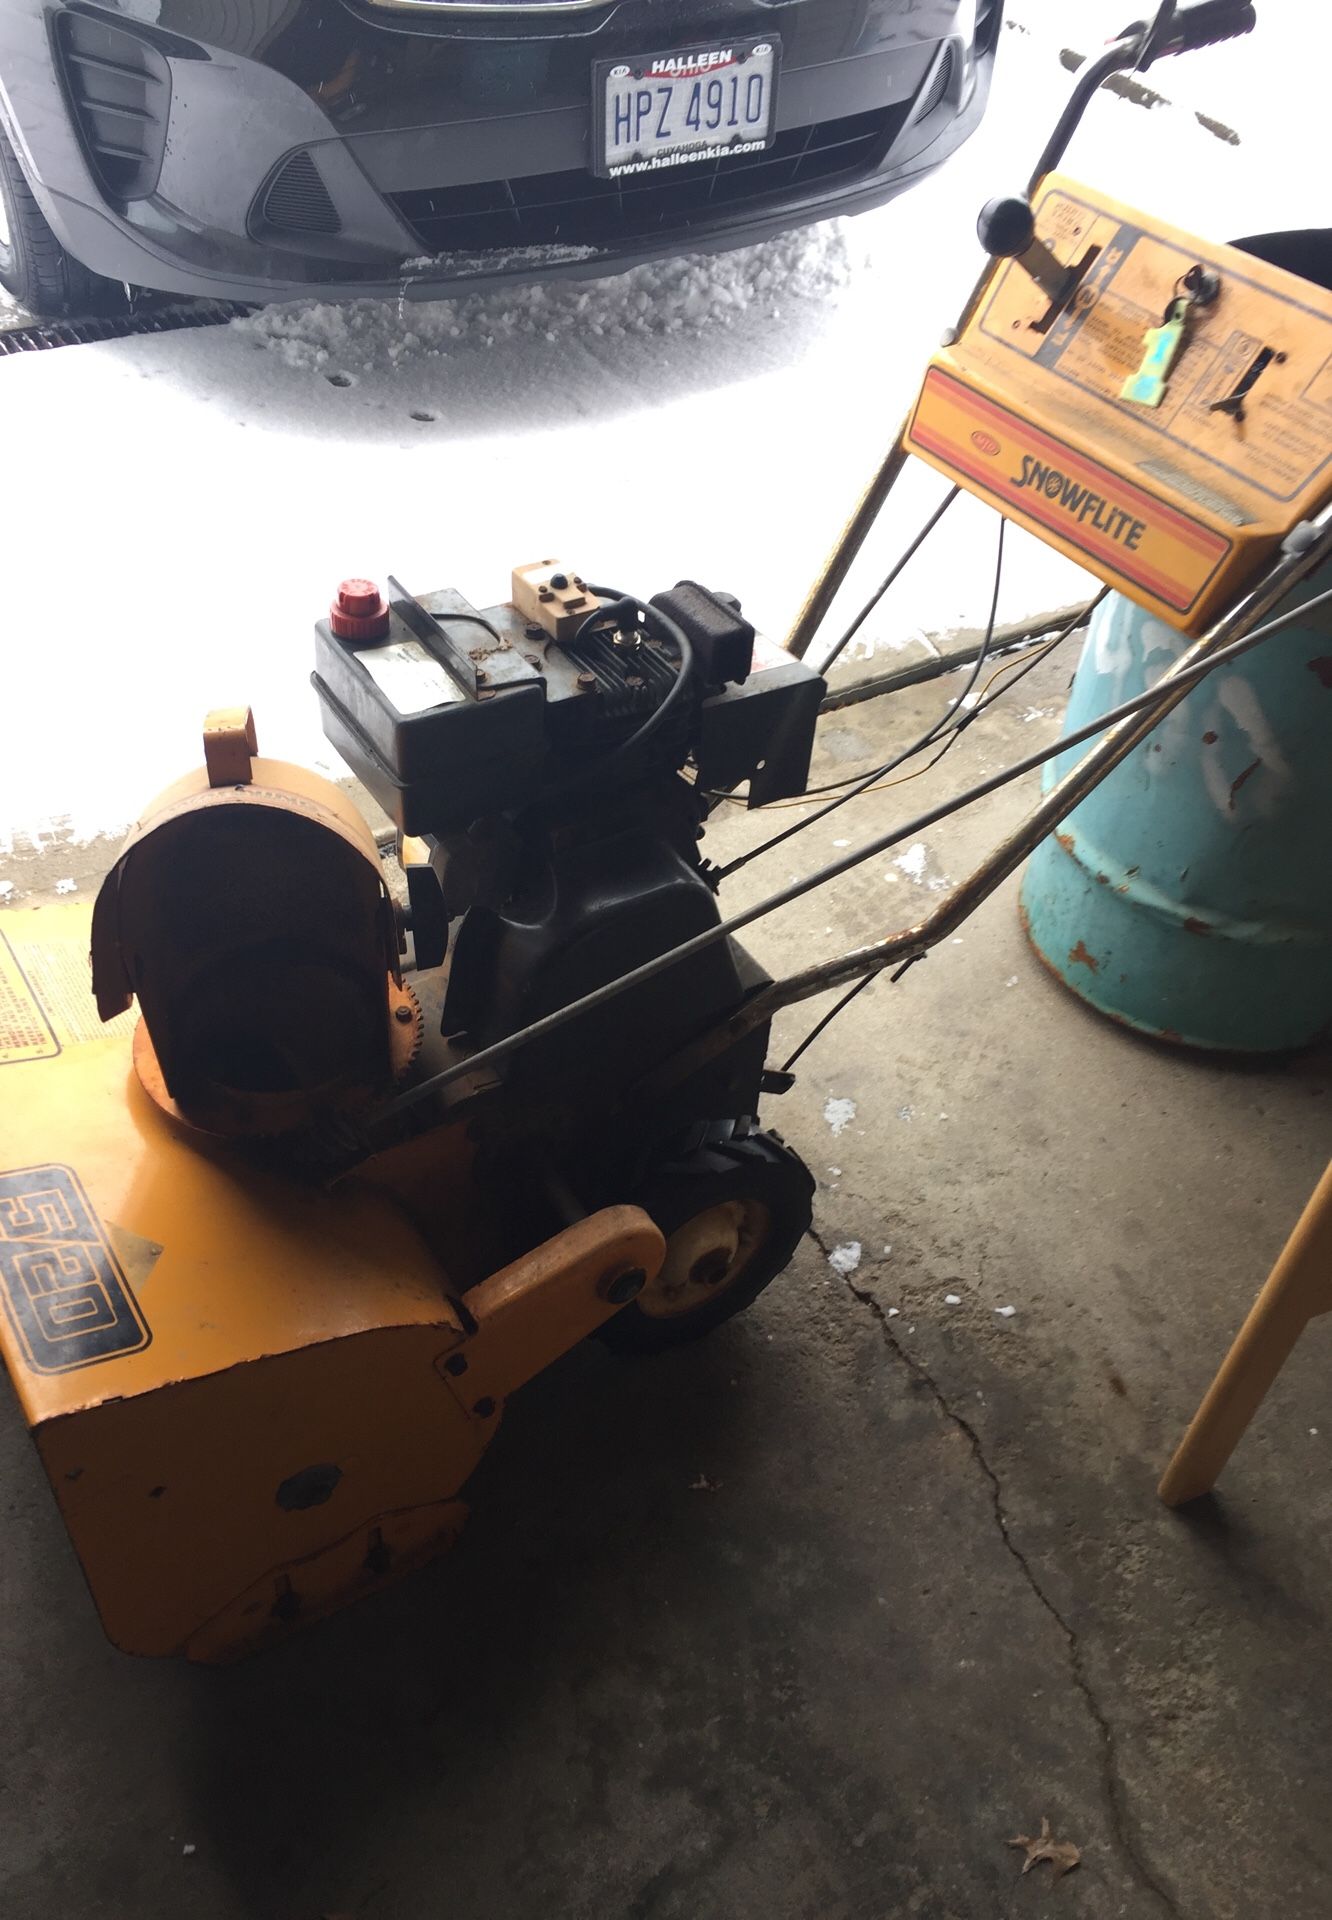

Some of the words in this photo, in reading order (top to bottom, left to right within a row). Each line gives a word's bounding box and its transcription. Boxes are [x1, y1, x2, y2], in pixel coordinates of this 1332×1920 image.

[651, 49, 733, 74] HALLEEN
[614, 87, 672, 145] HPZ
[685, 74, 763, 132] 4910
[608, 140, 766, 178] www.halleenkia.com
[1010, 454, 1147, 550] SNOWFLITE
